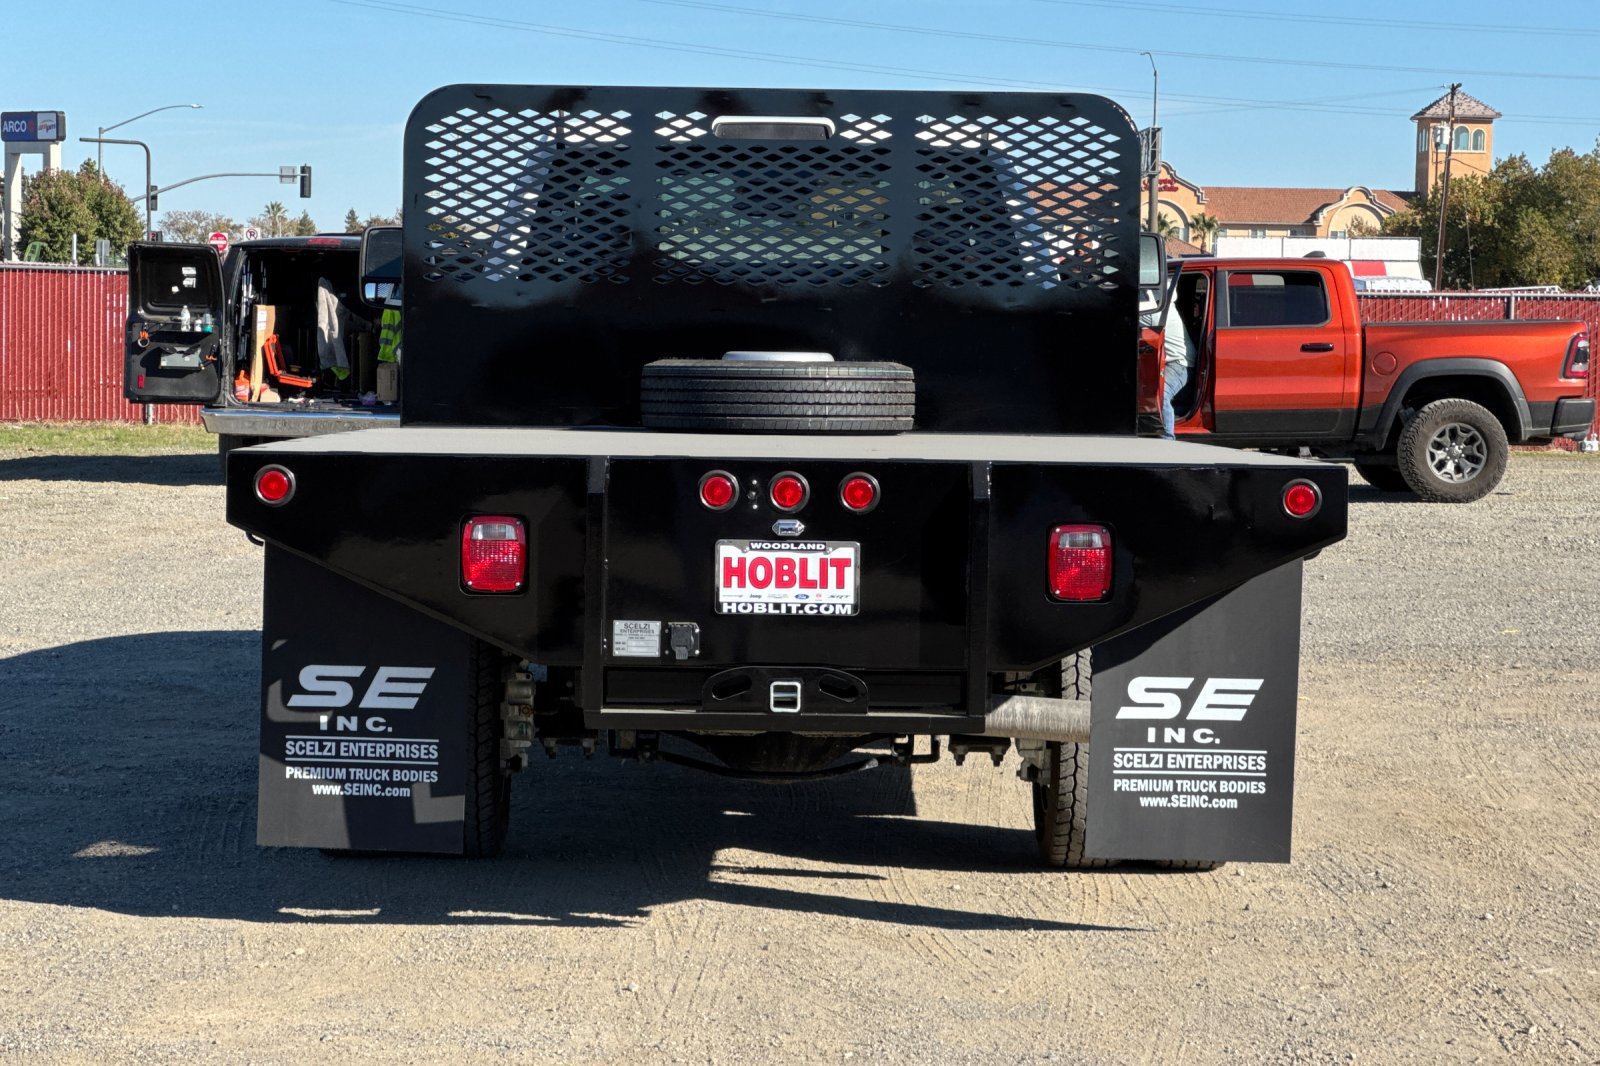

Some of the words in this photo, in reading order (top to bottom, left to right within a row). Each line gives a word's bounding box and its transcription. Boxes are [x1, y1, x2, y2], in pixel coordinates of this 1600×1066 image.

[2, 120, 27, 133] ARCO
[750, 542, 826, 550] WOODLAND
[723, 556, 852, 589] HOBLIT
[722, 602, 852, 615] HOBLIT.COM
[319, 715, 393, 733] INC.
[1147, 727, 1221, 744] INC.
[285, 741, 336, 756] SCELZI
[339, 742, 439, 759] ENTERPRISES
[1113, 753, 1163, 768] SCELZI
[1167, 754, 1267, 770] ENTERPRISES
[285, 766, 347, 780] PREMIUM
[349, 768, 390, 782] TRUCK
[392, 769, 439, 783] BODIES
[312, 783, 411, 797] www.SEINC.com
[1113, 778, 1174, 792] PREMIUM
[1175, 779, 1217, 793] TRUCK
[1219, 781, 1267, 794] BODIES
[1139, 795, 1238, 809] www.SEINC.com
